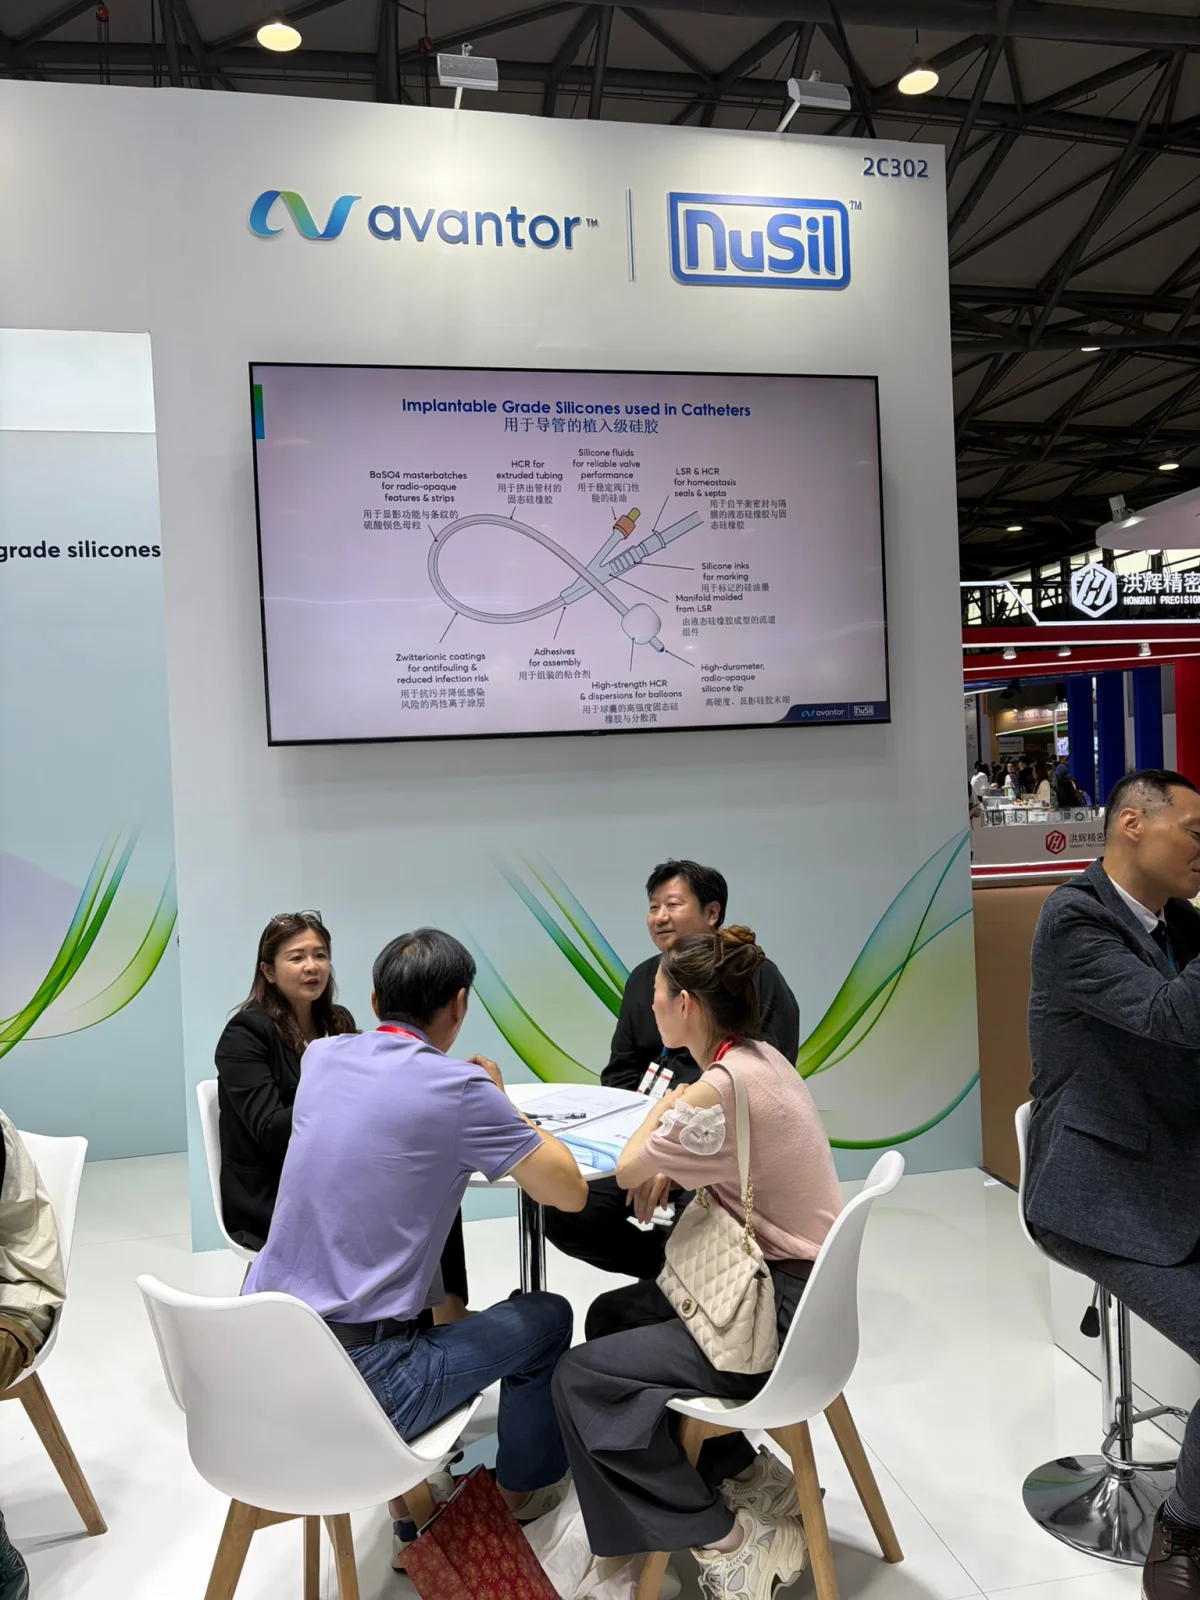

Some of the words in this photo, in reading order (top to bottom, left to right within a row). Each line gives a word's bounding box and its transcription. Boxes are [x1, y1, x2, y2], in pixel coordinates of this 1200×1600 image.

[862, 156, 929, 179] 2C302
[368, 204, 581, 250] avantor
[684, 208, 837, 276] NuSil
[402, 398, 497, 414] Implantable
[502, 400, 551, 414] Grade
[556, 401, 621, 415] Silicones
[625, 402, 660, 416] used
[664, 403, 677, 416] in
[681, 403, 751, 417] Catheters
[503, 417, 659, 434] 用于导管的植入级硅胶
[578, 448, 610, 457] Silicone
[612, 448, 634, 457] fluids
[511, 460, 531, 468] HCR
[533, 460, 545, 468] for
[573, 459, 584, 468] for
[586, 459, 617, 468] reliable
[619, 459, 641, 468] valve
[369, 470, 400, 479] BaSO4
[403, 471, 467, 480] masterbatches
[496, 471, 534, 480] extruded
[536, 471, 563, 481] tubing
[581, 470, 634, 480] performance
[675, 467, 691, 475] LSR
[694, 467, 700, 475] &
[701, 467, 720, 476] HCR
[381, 481, 394, 490] for
[396, 482, 457, 492] radio-opaque
[577, 482, 640, 492] 用于稳定阀门性
[674, 478, 685, 486] for
[687, 478, 737, 486] homeostasis
[497, 483, 562, 493] 用于挤出管材的
[384, 493, 420, 502] features
[423, 493, 429, 502] &
[431, 493, 455, 503] strips
[507, 494, 553, 504] 固态硅橡胶
[591, 493, 627, 503] 能的硅油
[674, 489, 694, 497] seals
[696, 489, 702, 497] &
[704, 490, 727, 499] septa
[709, 499, 787, 509] 用于自平衡密封与隔
[363, 509, 459, 519] 用于显影功能与条纹的
[709, 509, 787, 519] 膜的液态硅橡胶与固
[710, 520, 745, 530] 态硅橡胶
[67, 540, 161, 558] silicones
[701, 562, 732, 570] Silicone
[734, 561, 750, 570] inks
[703, 572, 714, 581] for
[716, 572, 749, 582] marking
[701, 582, 770, 593] 用于标记的硅油墨
[1122, 571, 1200, 594] 洪辉精密
[675, 594, 711, 602] Manifold
[712, 593, 743, 601] molded
[1123, 595, 1156, 605] HONGHUI
[675, 605, 695, 613] from
[697, 605, 712, 613] LSR
[682, 627, 700, 637] 组件
[395, 653, 447, 662] Zwitterionic
[449, 652, 486, 662] coatings
[534, 648, 576, 657] Adhesives
[529, 658, 541, 667] for
[542, 658, 581, 668] assembly
[700, 663, 765, 673] High-durometer,
[408, 664, 420, 673] for
[422, 663, 469, 674] antifouling
[471, 663, 477, 672] &
[397, 675, 433, 684] reduced
[435, 675, 472, 684] infection
[475, 674, 489, 683] risk
[518, 669, 591, 680] 用于组装的粘合剂
[701, 674, 756, 683] radio-opaque
[591, 680, 647, 690] High-strength
[649, 679, 668, 688] HCR
[701, 685, 731, 693] silicone
[733, 684, 744, 693] tip
[400, 687, 485, 699] 用于抗污并降低感染
[580, 693, 586, 701] &
[588, 691, 633, 703] dispersions
[635, 691, 646, 700] for
[648, 690, 683, 699] balloons
[400, 698, 485, 710] 风险的两性离子涂层
[582, 702, 679, 714] 用于球囊的高强度固态硅
[816, 708, 844, 716] avantor
[604, 713, 658, 725] 橡胶与分散液
